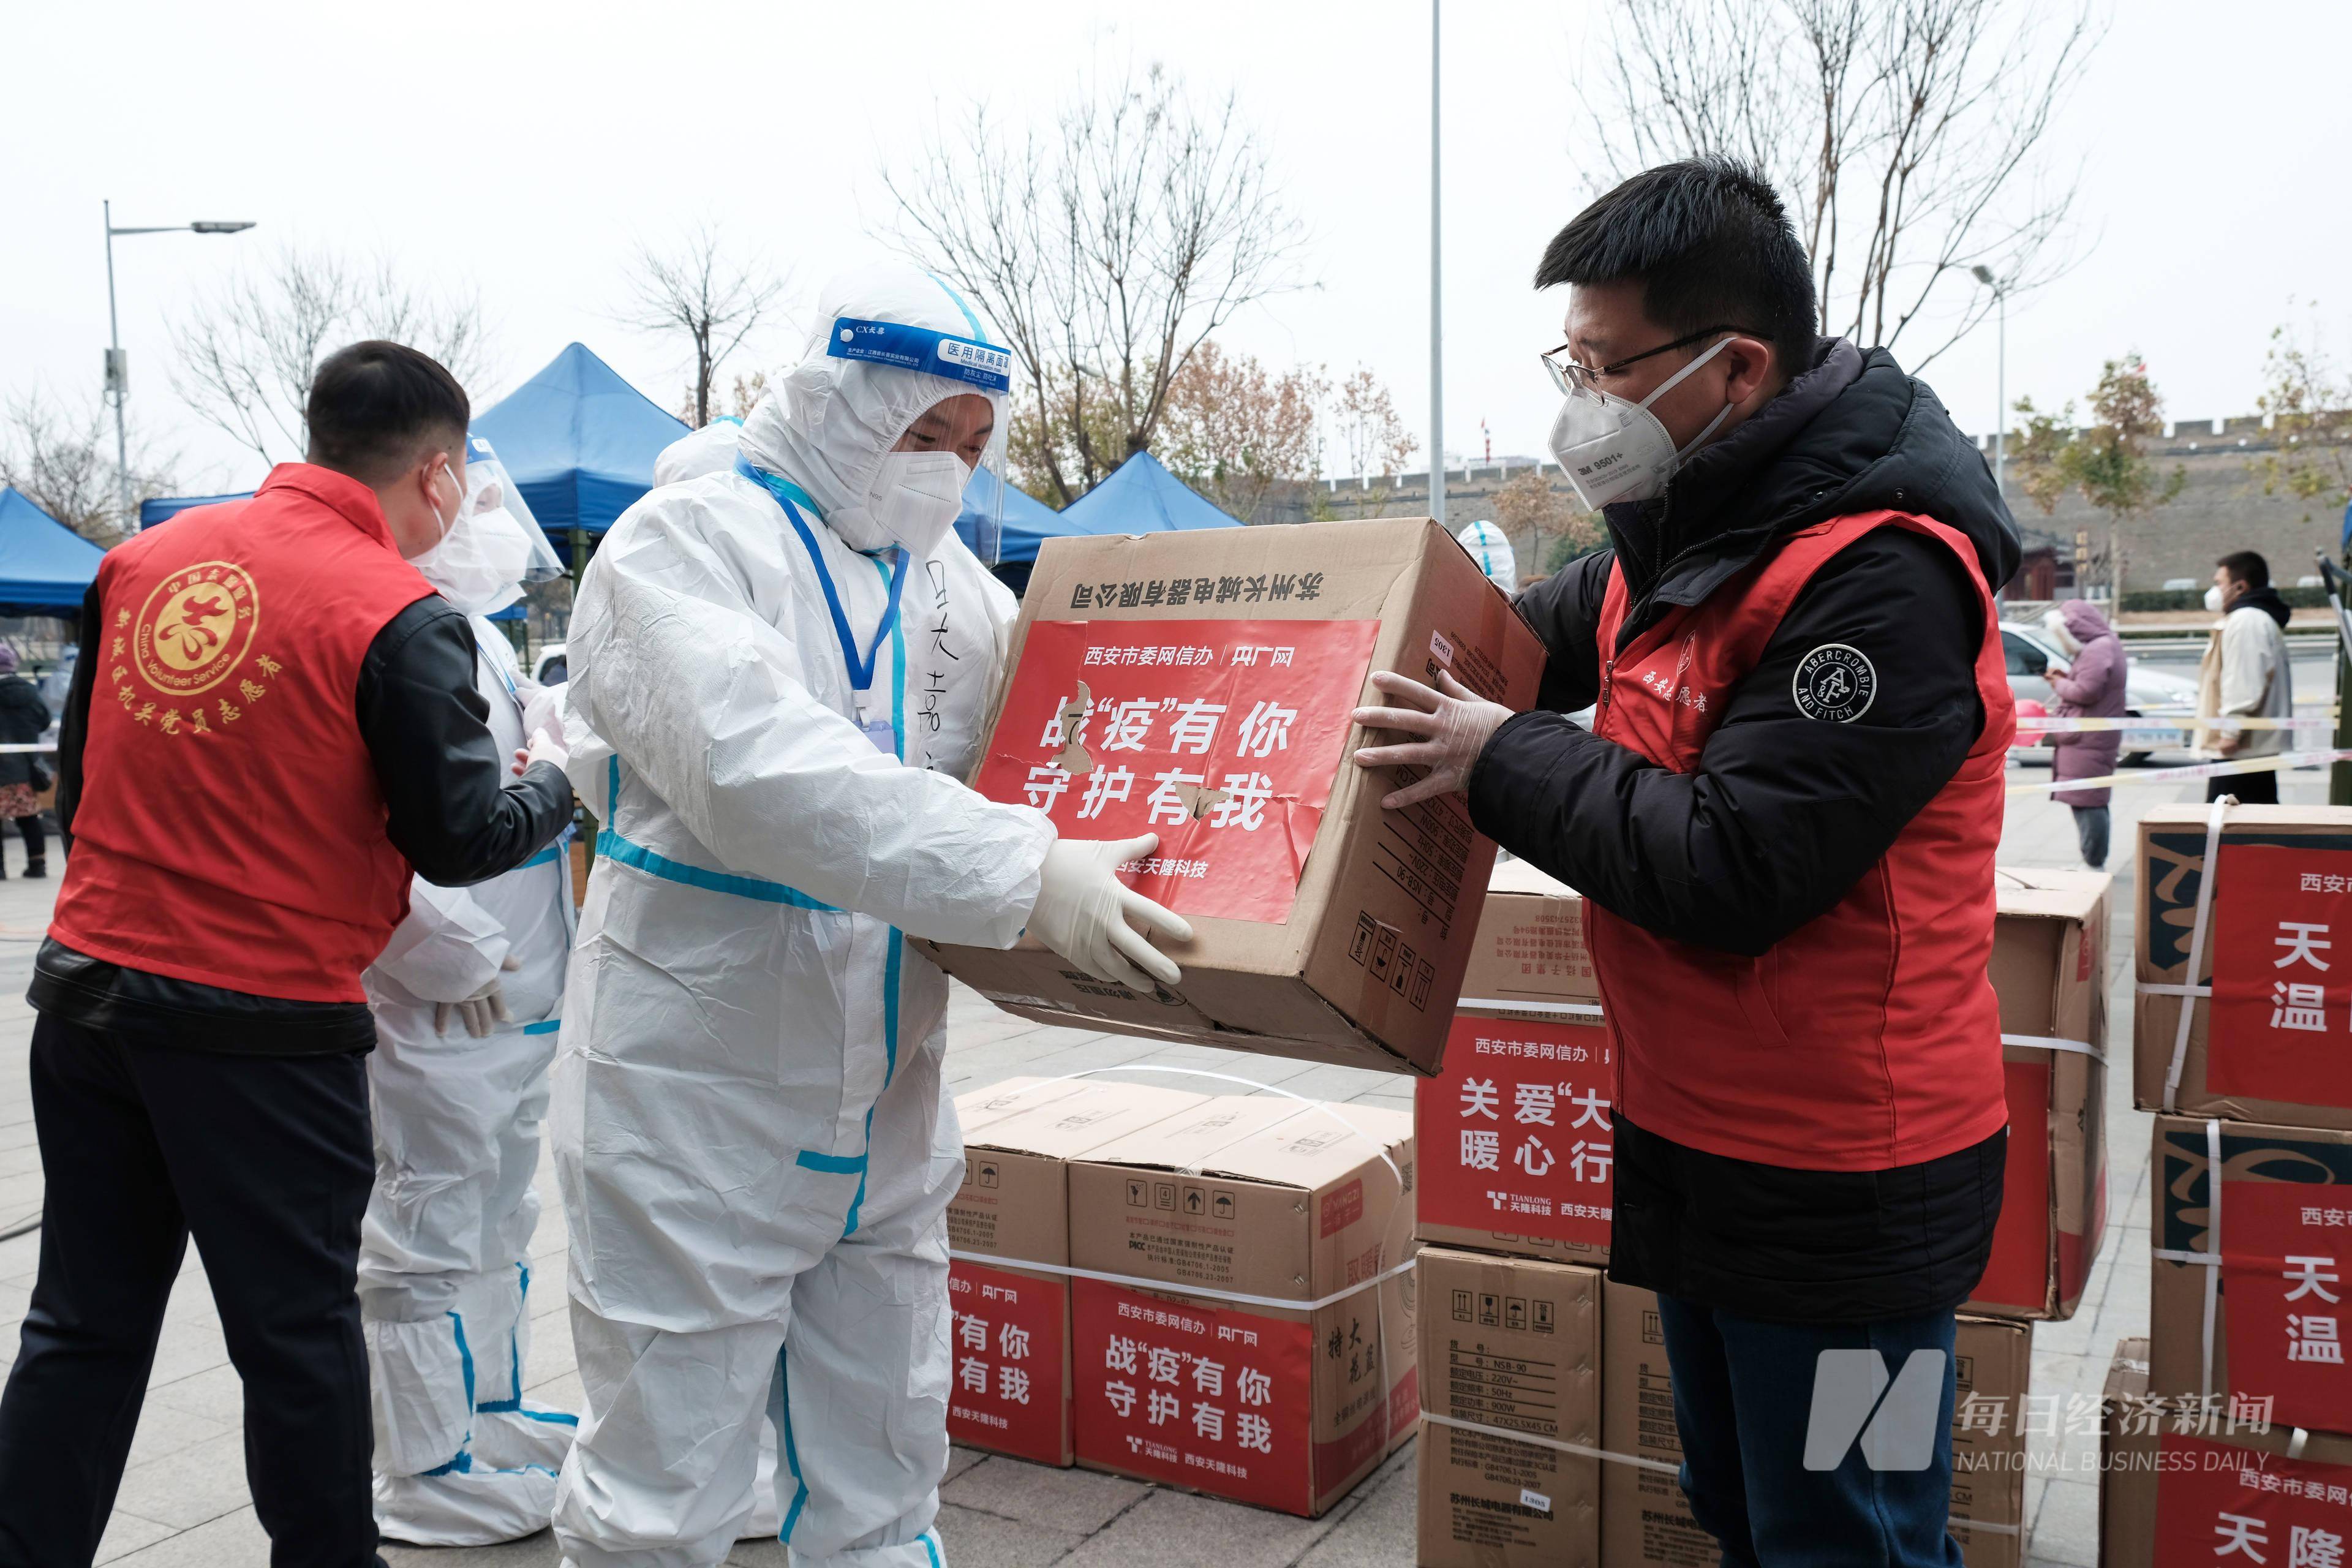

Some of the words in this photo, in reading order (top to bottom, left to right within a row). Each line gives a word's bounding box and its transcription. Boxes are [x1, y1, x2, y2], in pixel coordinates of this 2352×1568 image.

[1578, 466, 1593, 475] 3M
[1594, 453, 1623, 470] 9501+
[869, 491, 883, 502] N95
[1070, 571, 1325, 610] 苏州长城电器有限公司
[141, 624, 152, 659] China
[147, 659, 192, 687] Volunteer
[194, 653, 230, 685] Service
[1084, 646, 1214, 667] 西安市委网信办
[1231, 646, 1296, 668] 央广网
[1434, 637, 1451, 657] 1305
[1804, 650, 1871, 698] ABERCROMBIE
[1798, 688, 1814, 709] AND
[1814, 706, 1853, 720] FITCH
[1022, 764, 1273, 832] 守护有我
[2273, 921, 2332, 972] 天
[2269, 981, 2352, 1033] 温
[1475, 1038, 1589, 1063] 西安市委网信办
[1460, 1129, 1613, 1183] 暖心行
[1510, 1194, 1551, 1205] TIANLONG
[1510, 1201, 1552, 1217] 天隆科技
[1129, 1240, 1146, 1251] PICC
[981, 1284, 1017, 1305] 央广网
[2282, 1255, 2340, 1305] 天
[1118, 1302, 1206, 1336] 西安市委网信办
[1218, 1325, 1258, 1348] 央广网
[2285, 1313, 2345, 1365] 温
[959, 1355, 1030, 1406] 有我
[1105, 1333, 1272, 1408] 战“疫”有你
[1494, 1360, 1527, 1373] NSB-90
[952, 1405, 1009, 1430] 西安天隆科技
[1105, 1380, 1272, 1455] 守护有我
[1543, 1424, 1559, 1434] CM
[1145, 1447, 1178, 1464] 天隆科技
[1184, 1452, 1248, 1480] 西安天隆科技
[2239, 1469, 2352, 1506] 西安市委网
